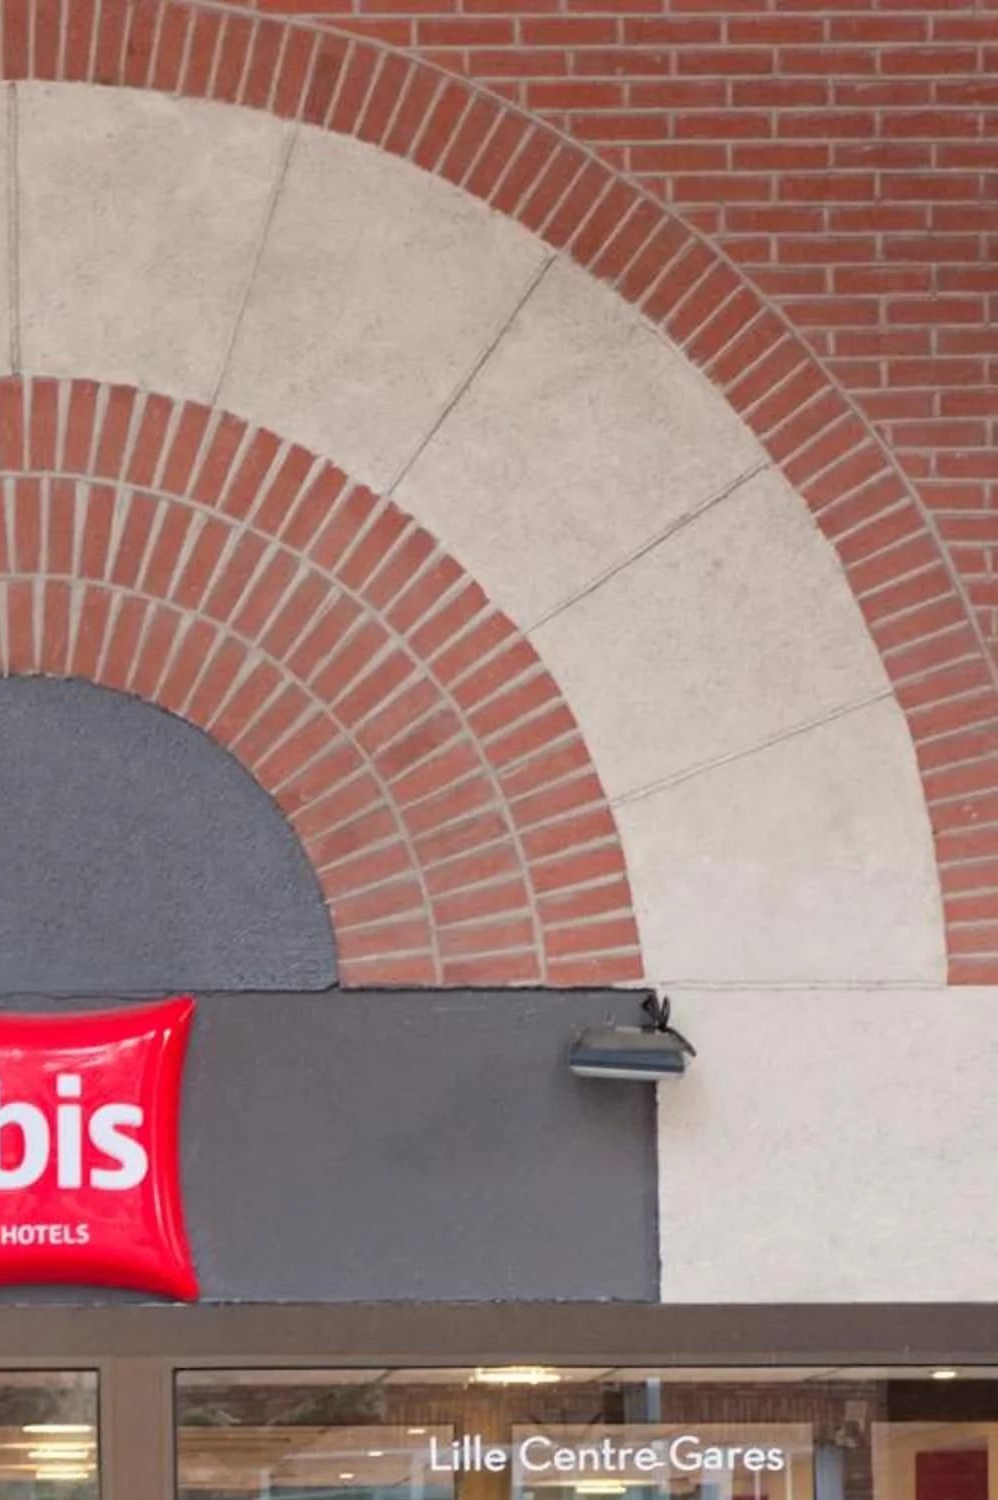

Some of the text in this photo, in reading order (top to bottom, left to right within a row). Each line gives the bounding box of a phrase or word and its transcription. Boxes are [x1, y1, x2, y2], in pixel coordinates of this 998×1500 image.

[1, 1224, 90, 1245] HOTELS
[430, 1436, 784, 1471] Lille Centre Gares
